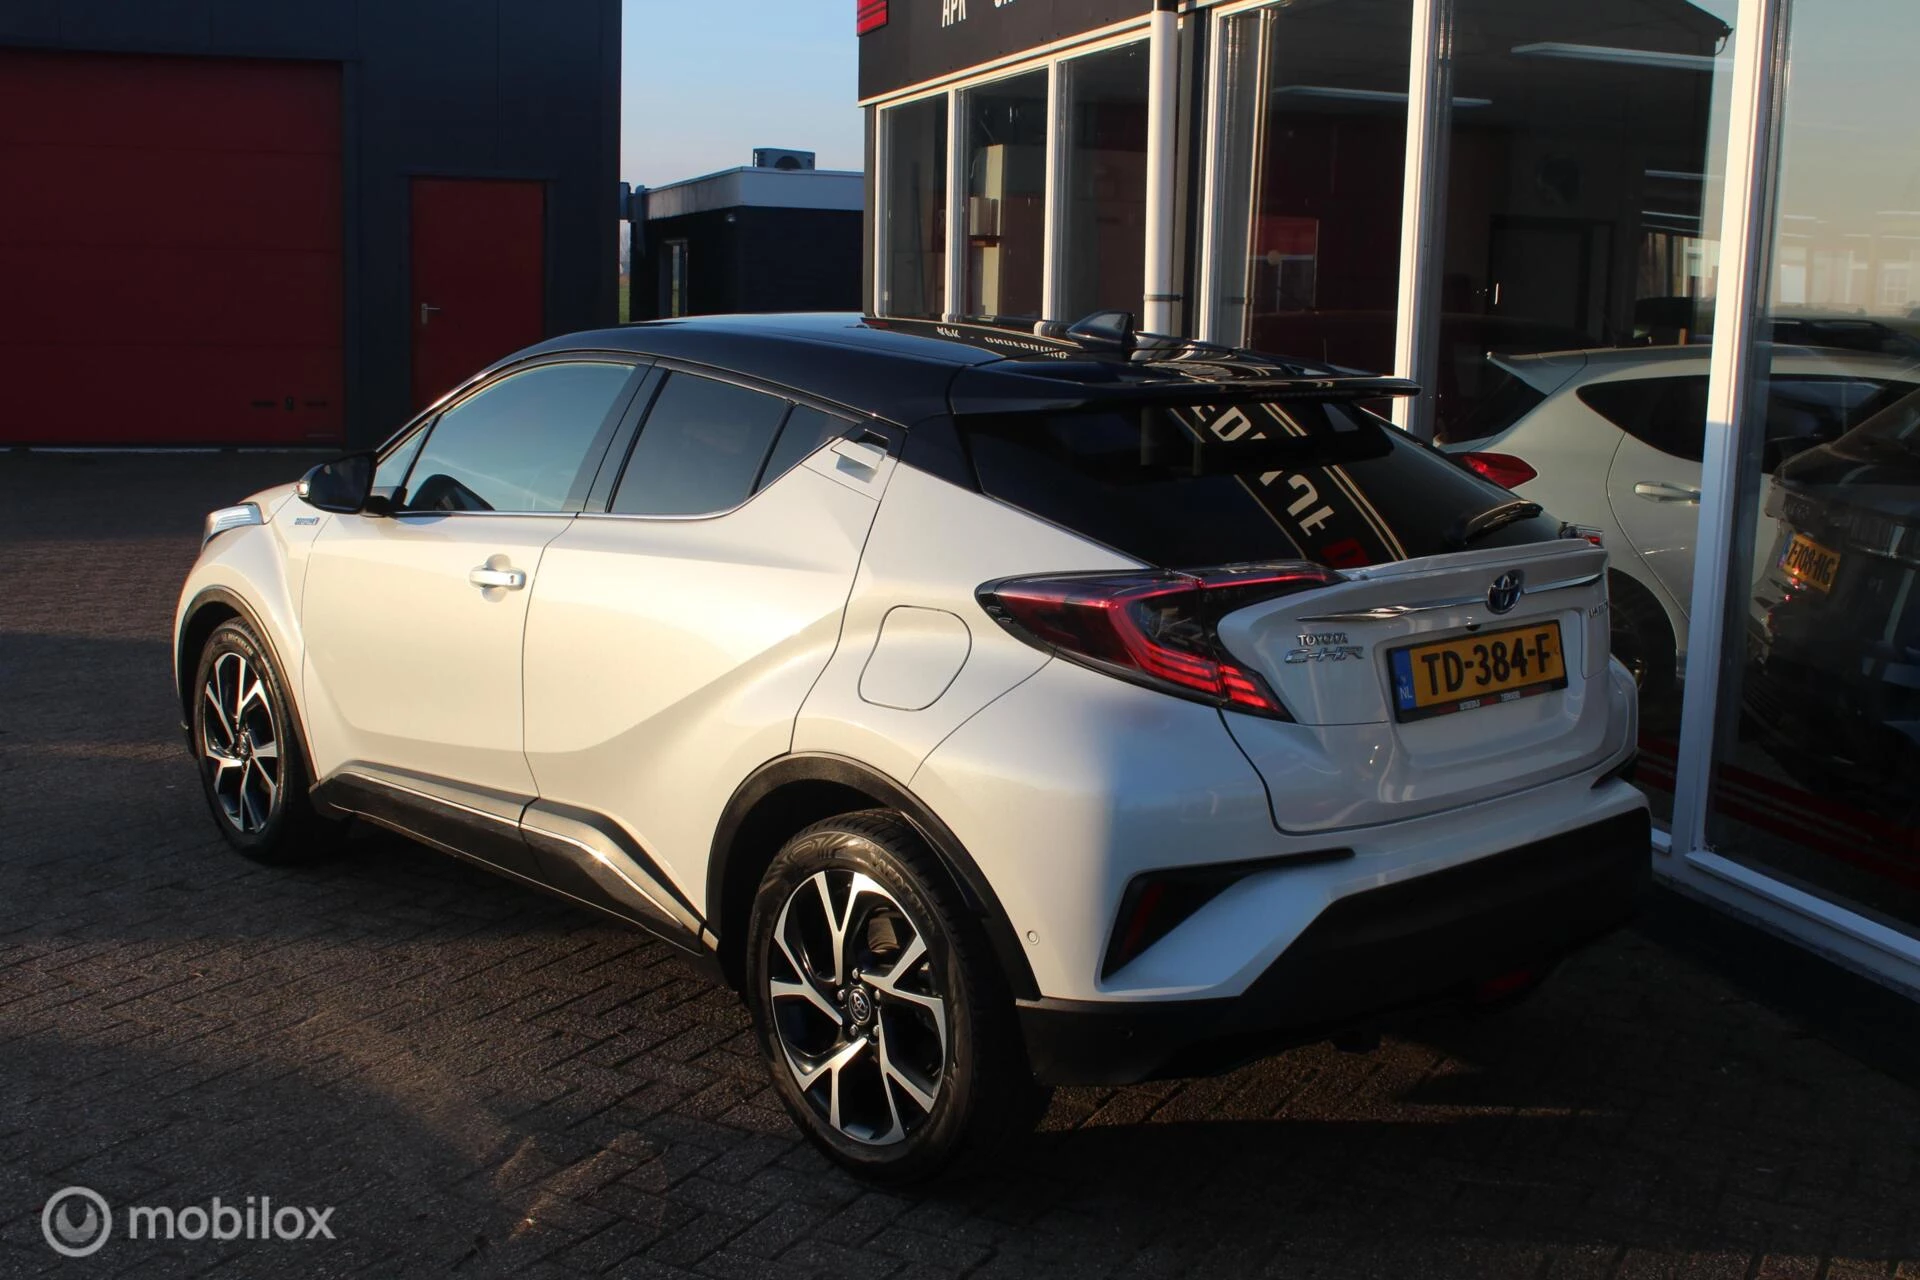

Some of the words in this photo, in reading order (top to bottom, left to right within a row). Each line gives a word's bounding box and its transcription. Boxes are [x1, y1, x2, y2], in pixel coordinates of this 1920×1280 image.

[1297, 632, 1348, 647] TOYOTA
[1284, 646, 1364, 664] C-HR
[1422, 634, 1550, 696] TD-384-F
[1400, 687, 1413, 698] NL
